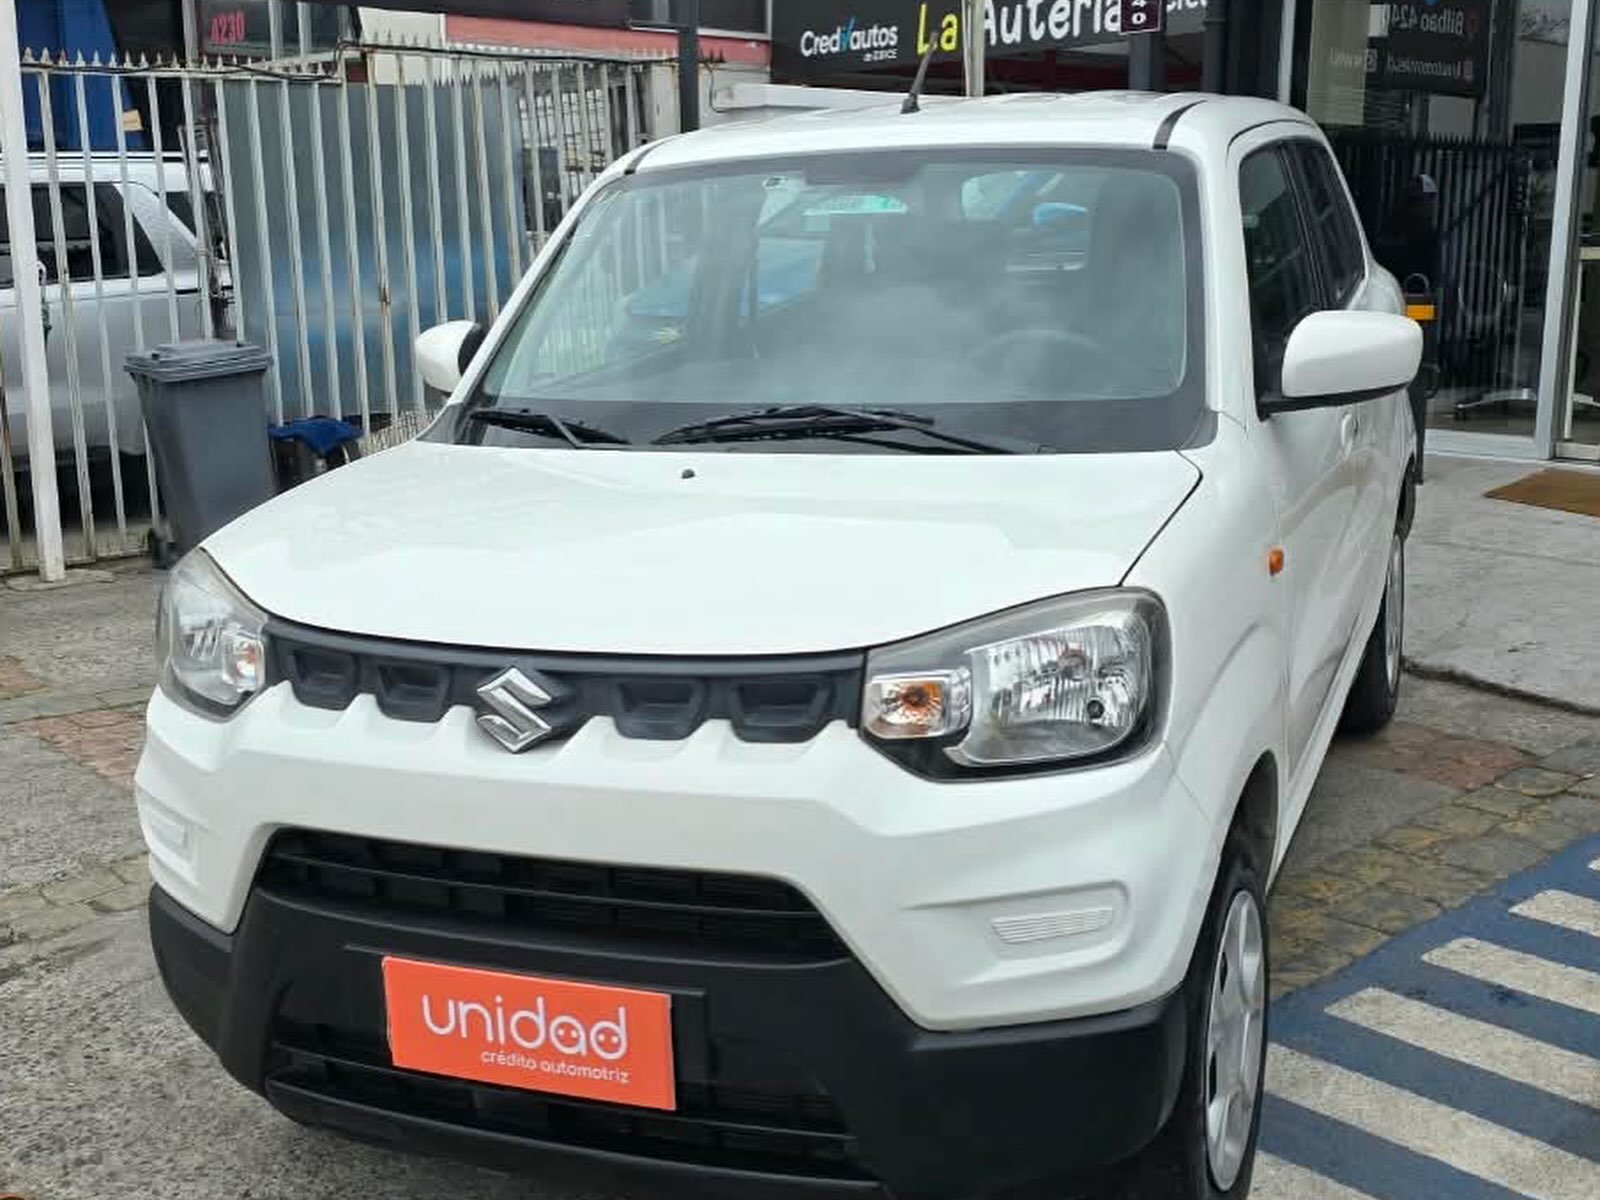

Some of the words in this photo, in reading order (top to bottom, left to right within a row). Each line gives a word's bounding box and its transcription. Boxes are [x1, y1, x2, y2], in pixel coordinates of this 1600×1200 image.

[916, 3, 958, 55] La
[421, 994, 627, 1061] unidad
[480, 1049, 537, 1071] crédito
[540, 1059, 631, 1085] automotriz
